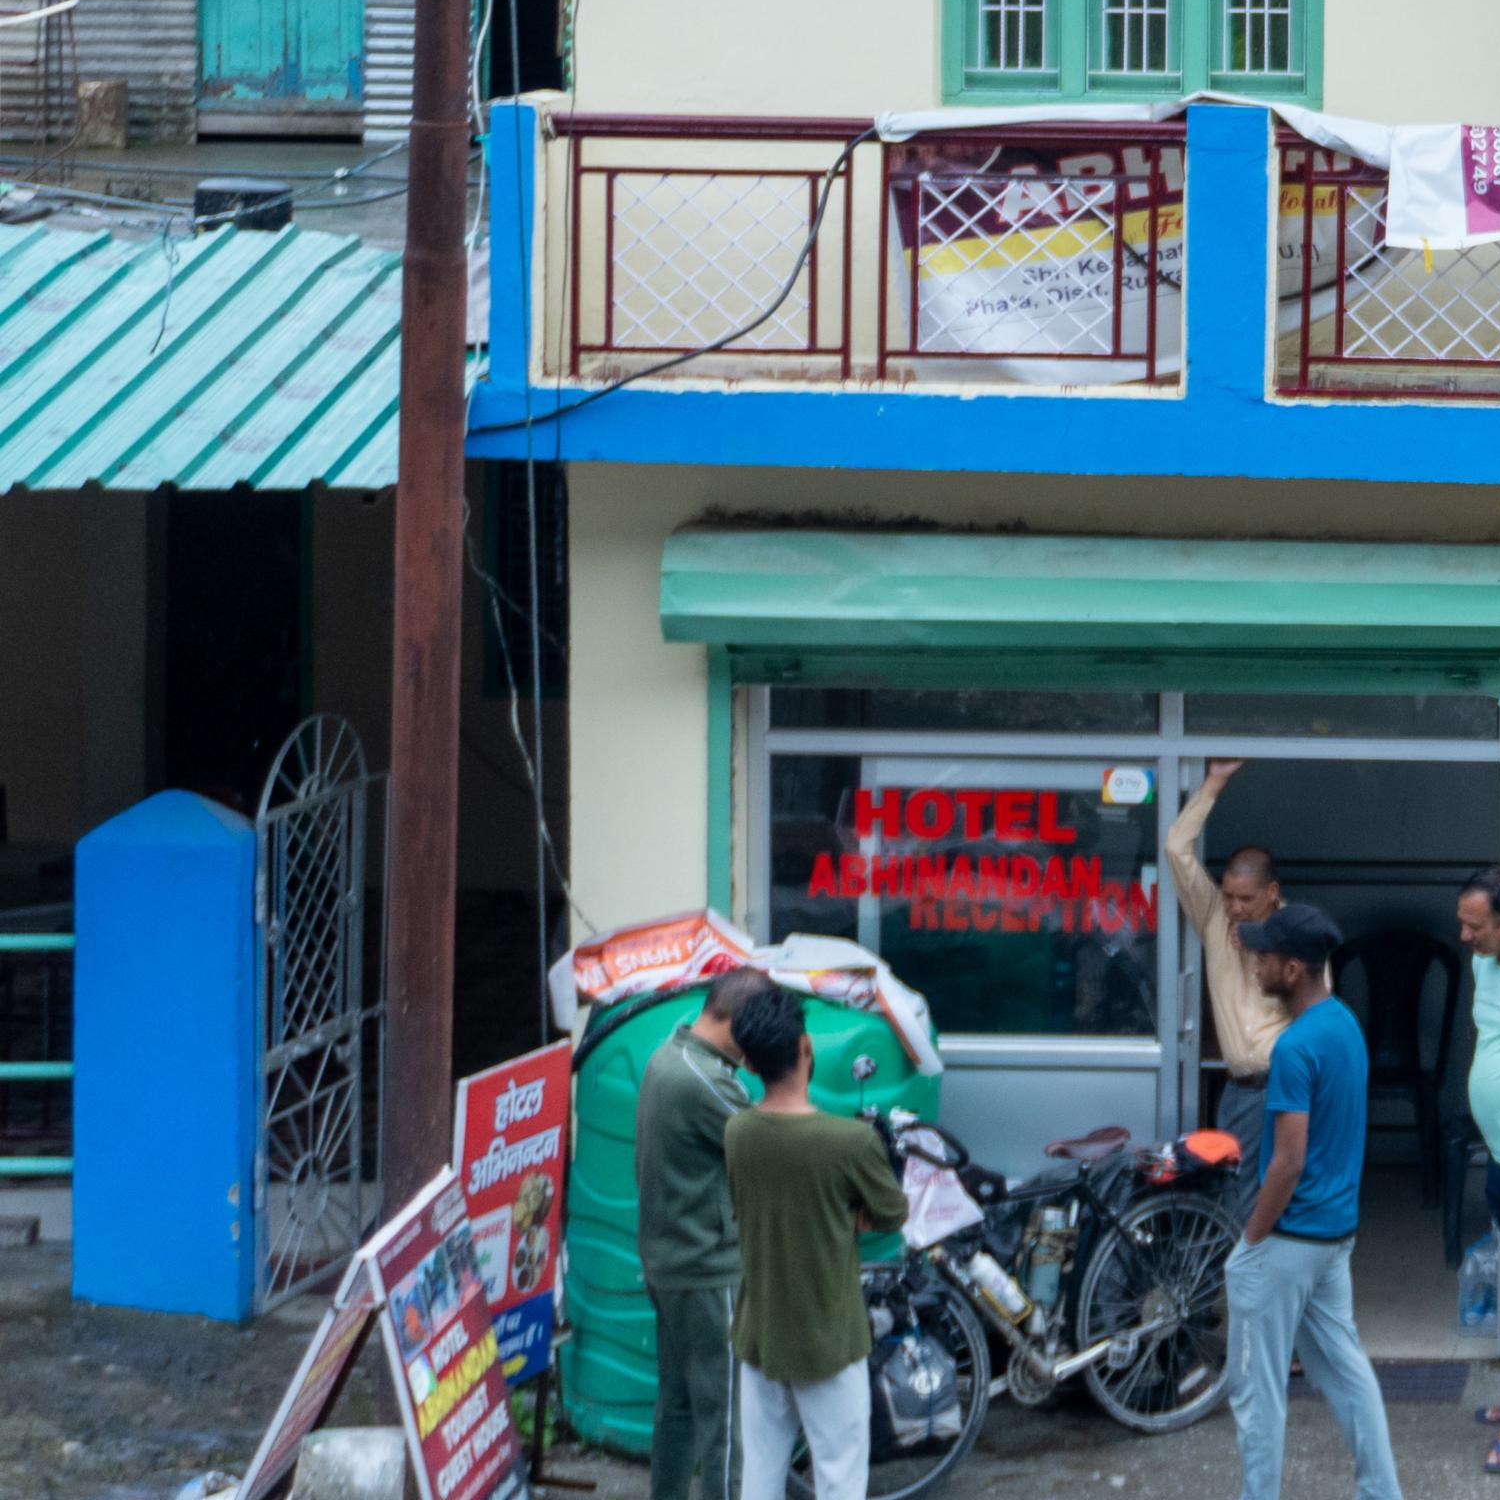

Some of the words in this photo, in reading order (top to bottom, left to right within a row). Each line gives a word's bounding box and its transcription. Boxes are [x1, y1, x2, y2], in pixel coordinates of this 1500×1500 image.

[854, 788, 1077, 843] HOTEL
[807, 853, 1102, 899] ABHINANDAN
[908, 880, 1158, 933] RECEPTION
[494, 1076, 547, 1132] होटल
[467, 1135, 562, 1195] अभिनन्दन
[430, 1319, 470, 1375] HOTEL
[441, 1381, 490, 1450] TOURIST
[436, 1439, 475, 1500] GUEST
[471, 1398, 510, 1462] HOUSE
